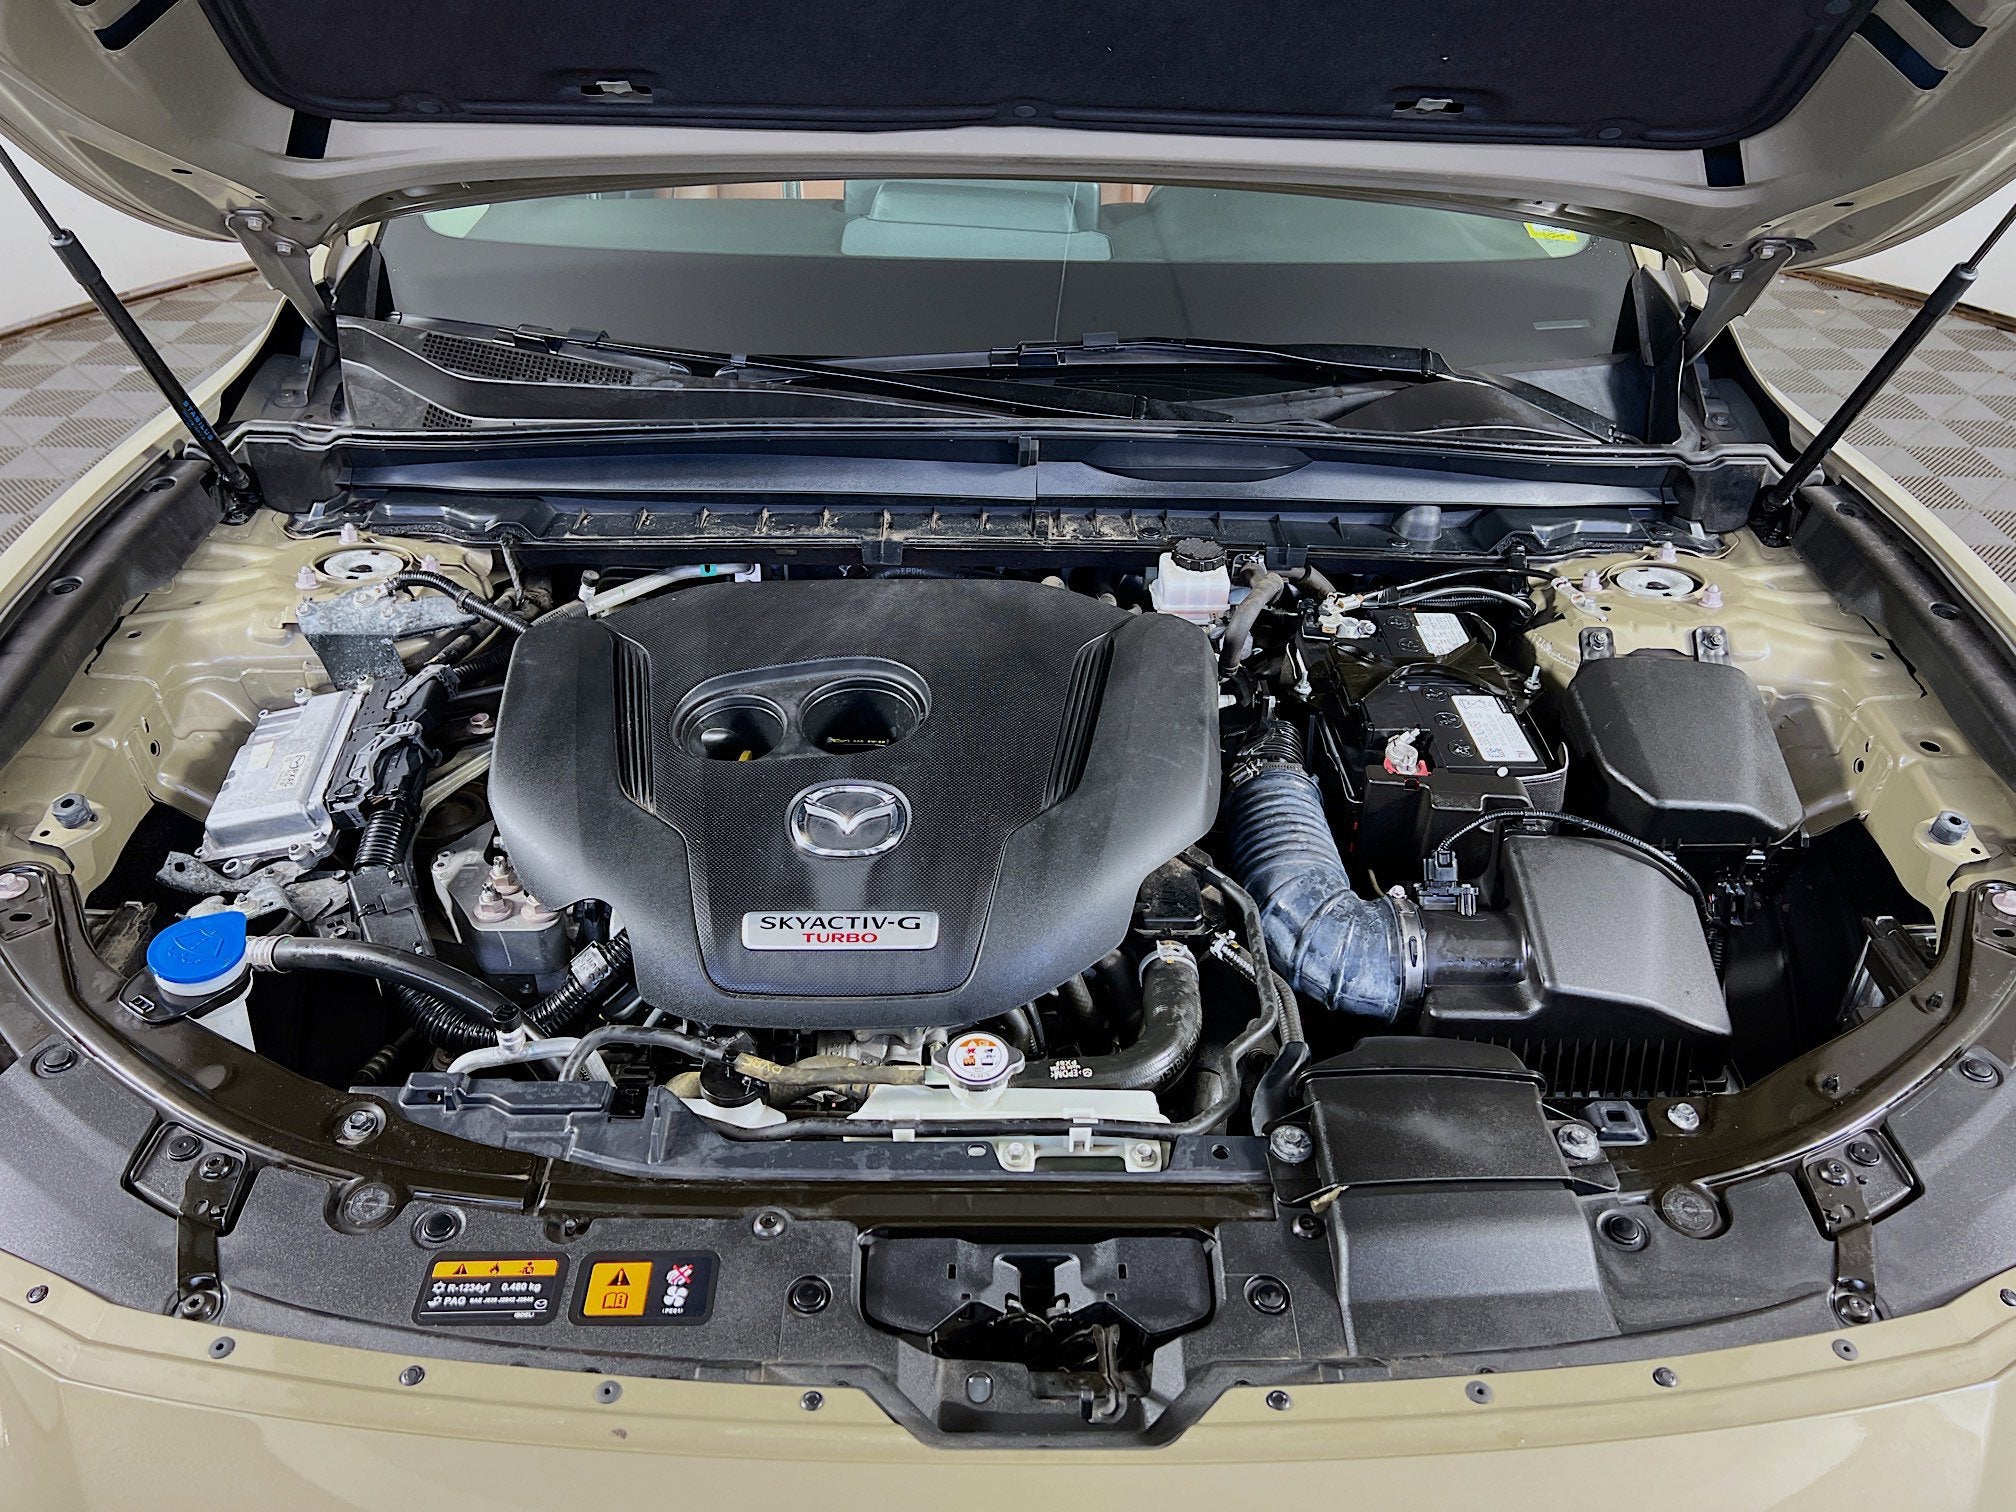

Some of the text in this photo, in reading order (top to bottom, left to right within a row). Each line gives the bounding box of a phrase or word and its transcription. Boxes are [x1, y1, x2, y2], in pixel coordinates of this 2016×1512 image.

[182, 400, 214, 441] STABILUS
[759, 916, 921, 930] SKYACTIV-G
[802, 932, 878, 943] TURBO
[447, 1282, 491, 1294] R-1234yf
[528, 1282, 542, 1293] kg
[443, 1296, 466, 1307] PAG
